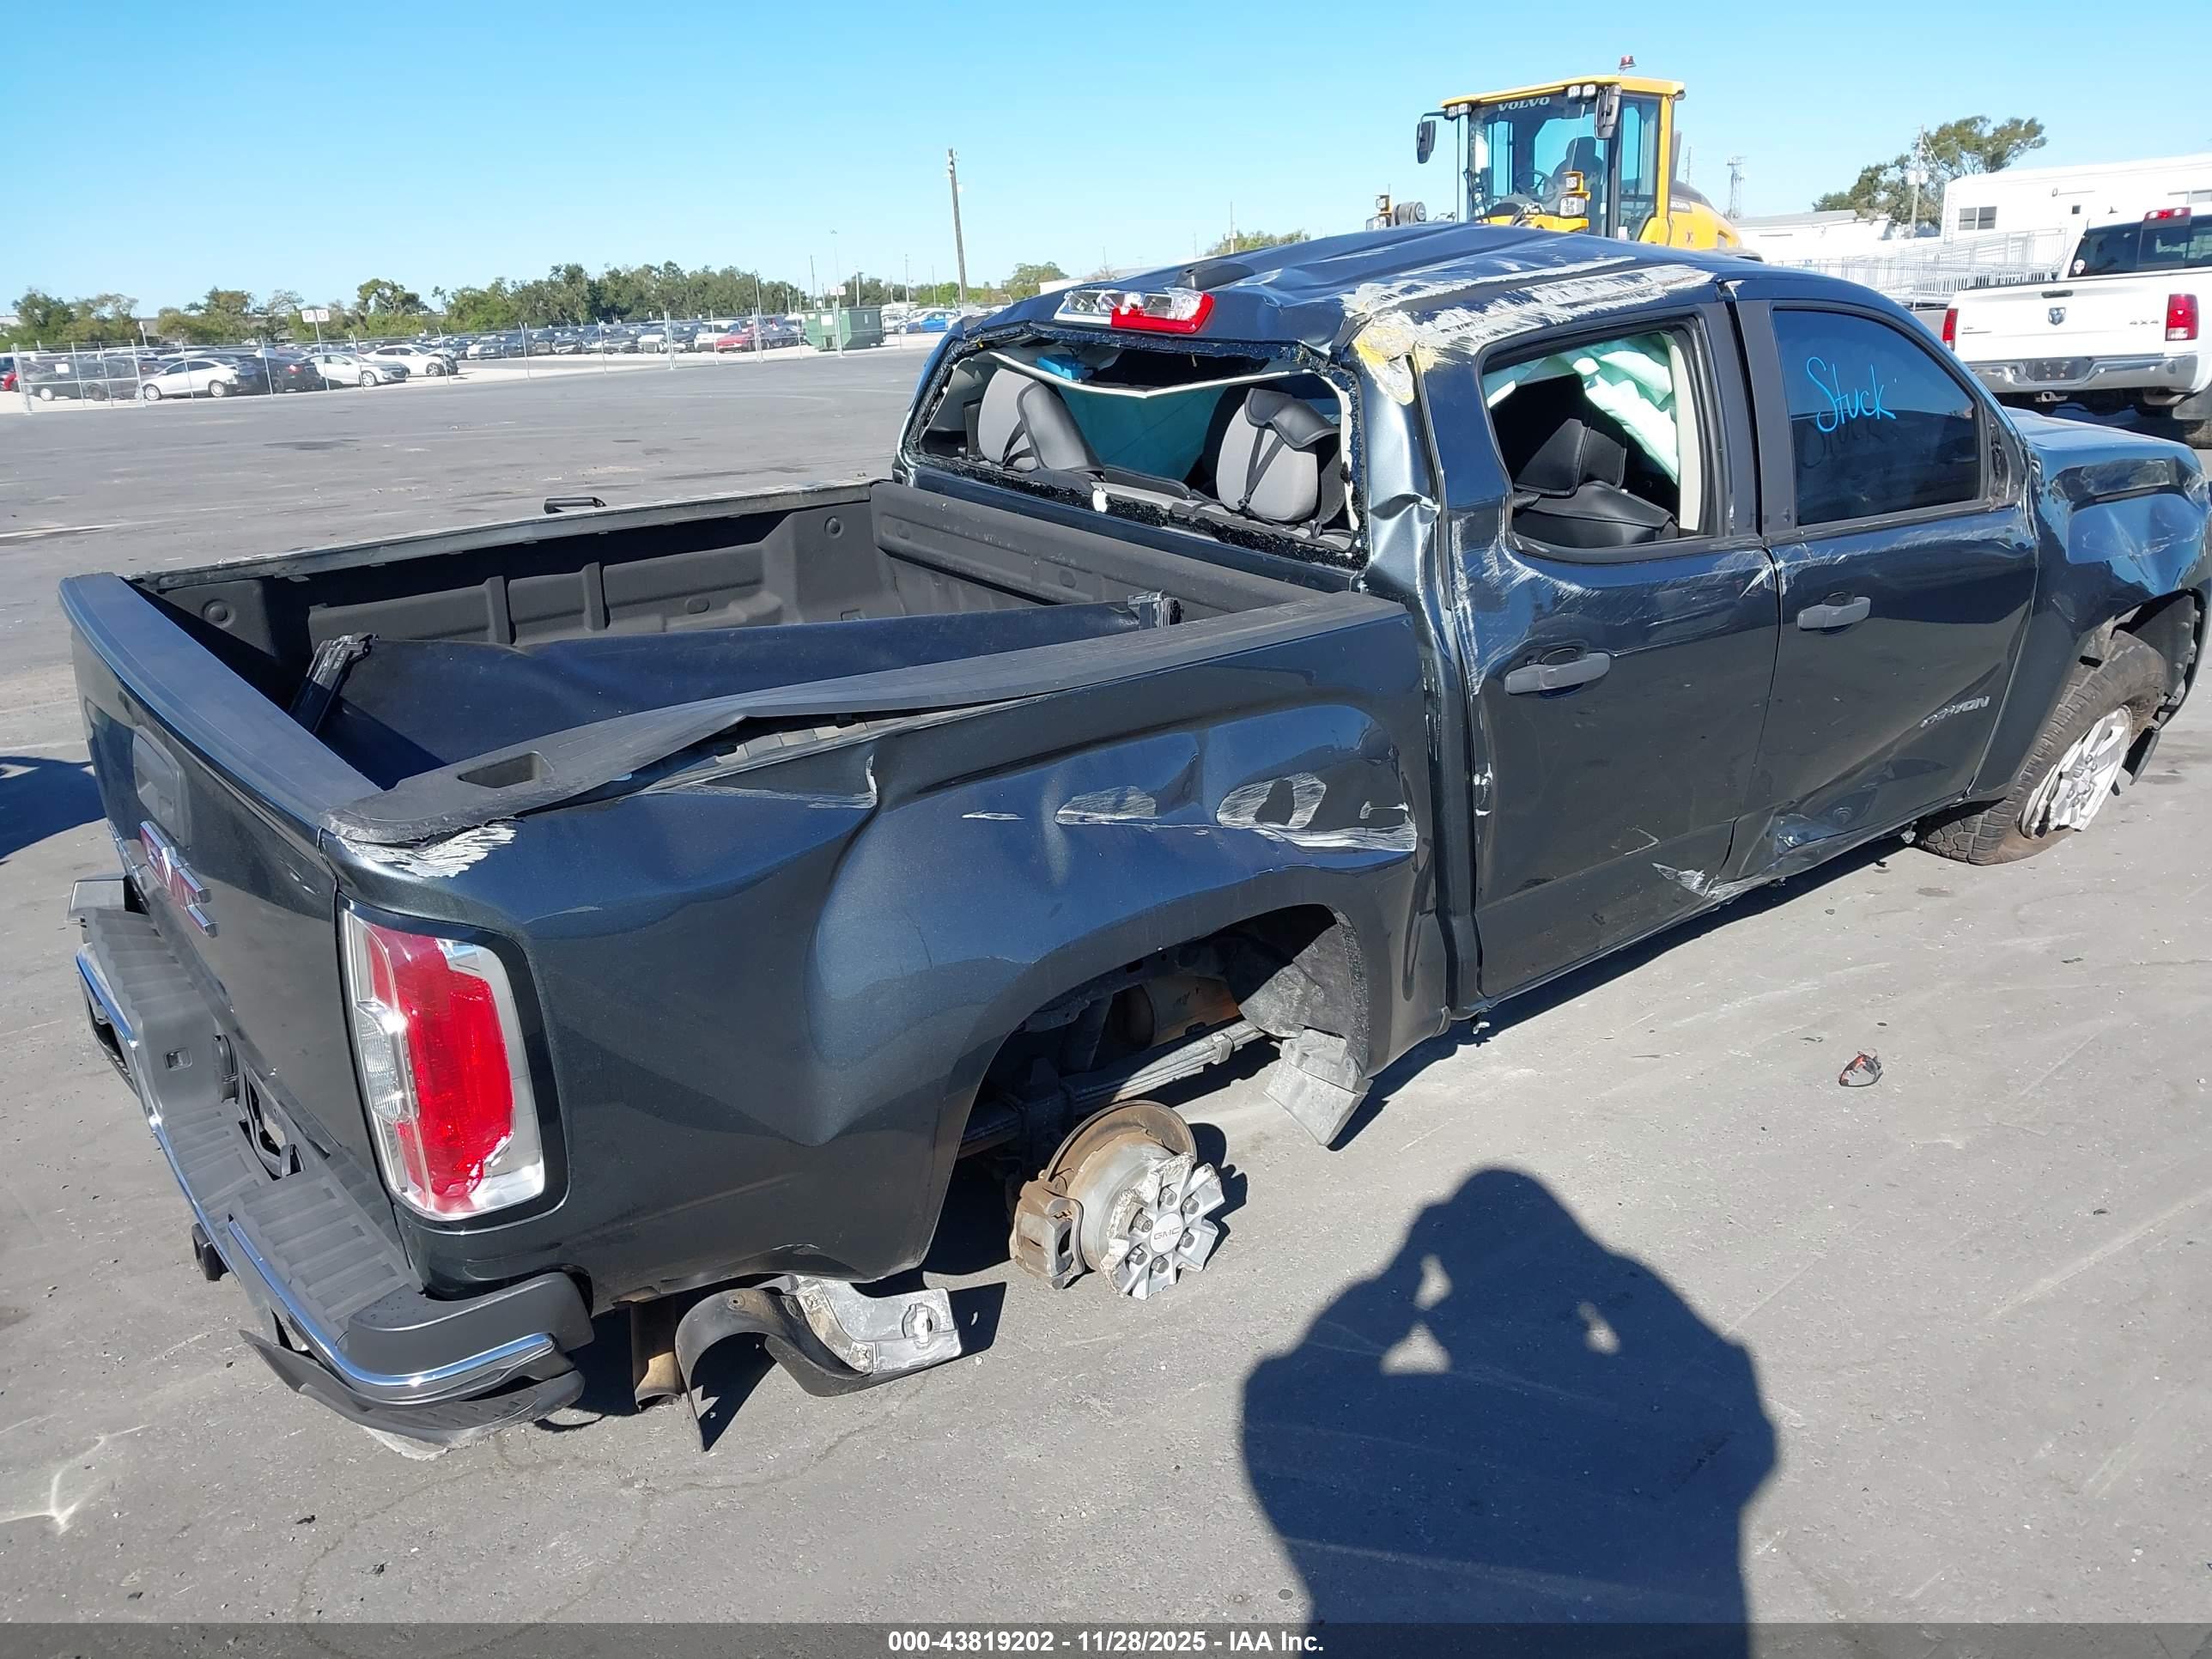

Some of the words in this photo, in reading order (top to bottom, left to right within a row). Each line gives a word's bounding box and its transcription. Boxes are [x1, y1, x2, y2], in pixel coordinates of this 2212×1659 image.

[1498, 96, 1550, 112] VOLVO
[1806, 356, 1896, 433] Stuck
[1154, 1226, 1181, 1240] GMC
